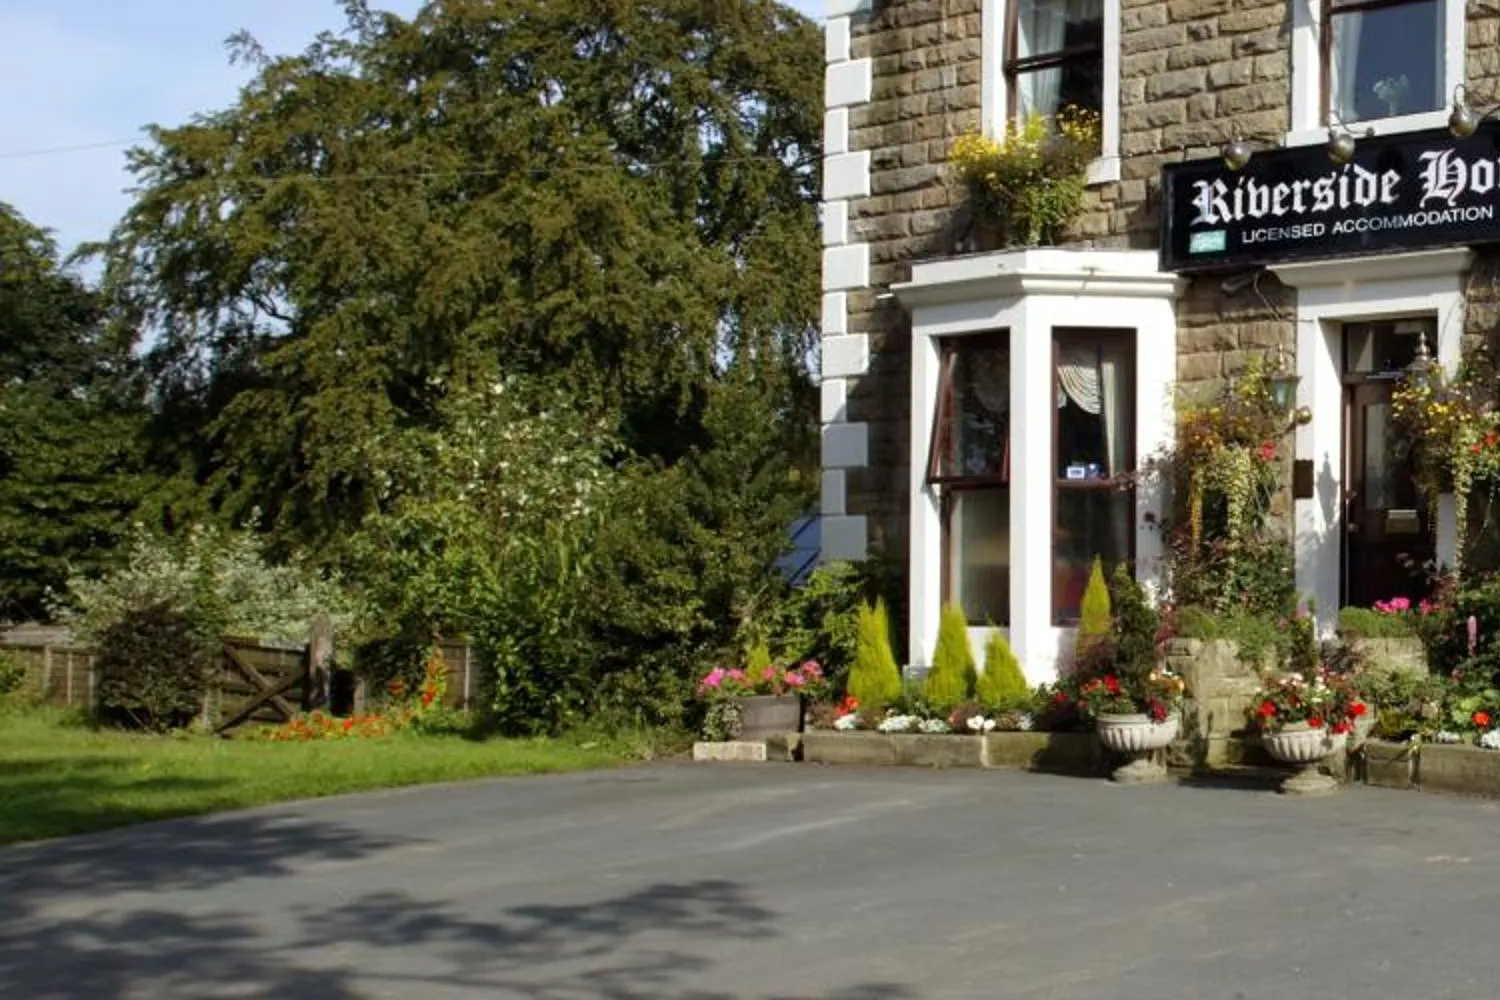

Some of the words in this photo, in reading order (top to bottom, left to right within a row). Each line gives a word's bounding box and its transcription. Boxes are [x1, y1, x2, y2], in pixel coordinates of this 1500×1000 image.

[1190, 163, 1401, 226] Riverside
[1241, 222, 1325, 244] LICENSED
[1332, 204, 1494, 235] ACCOMMODATION
